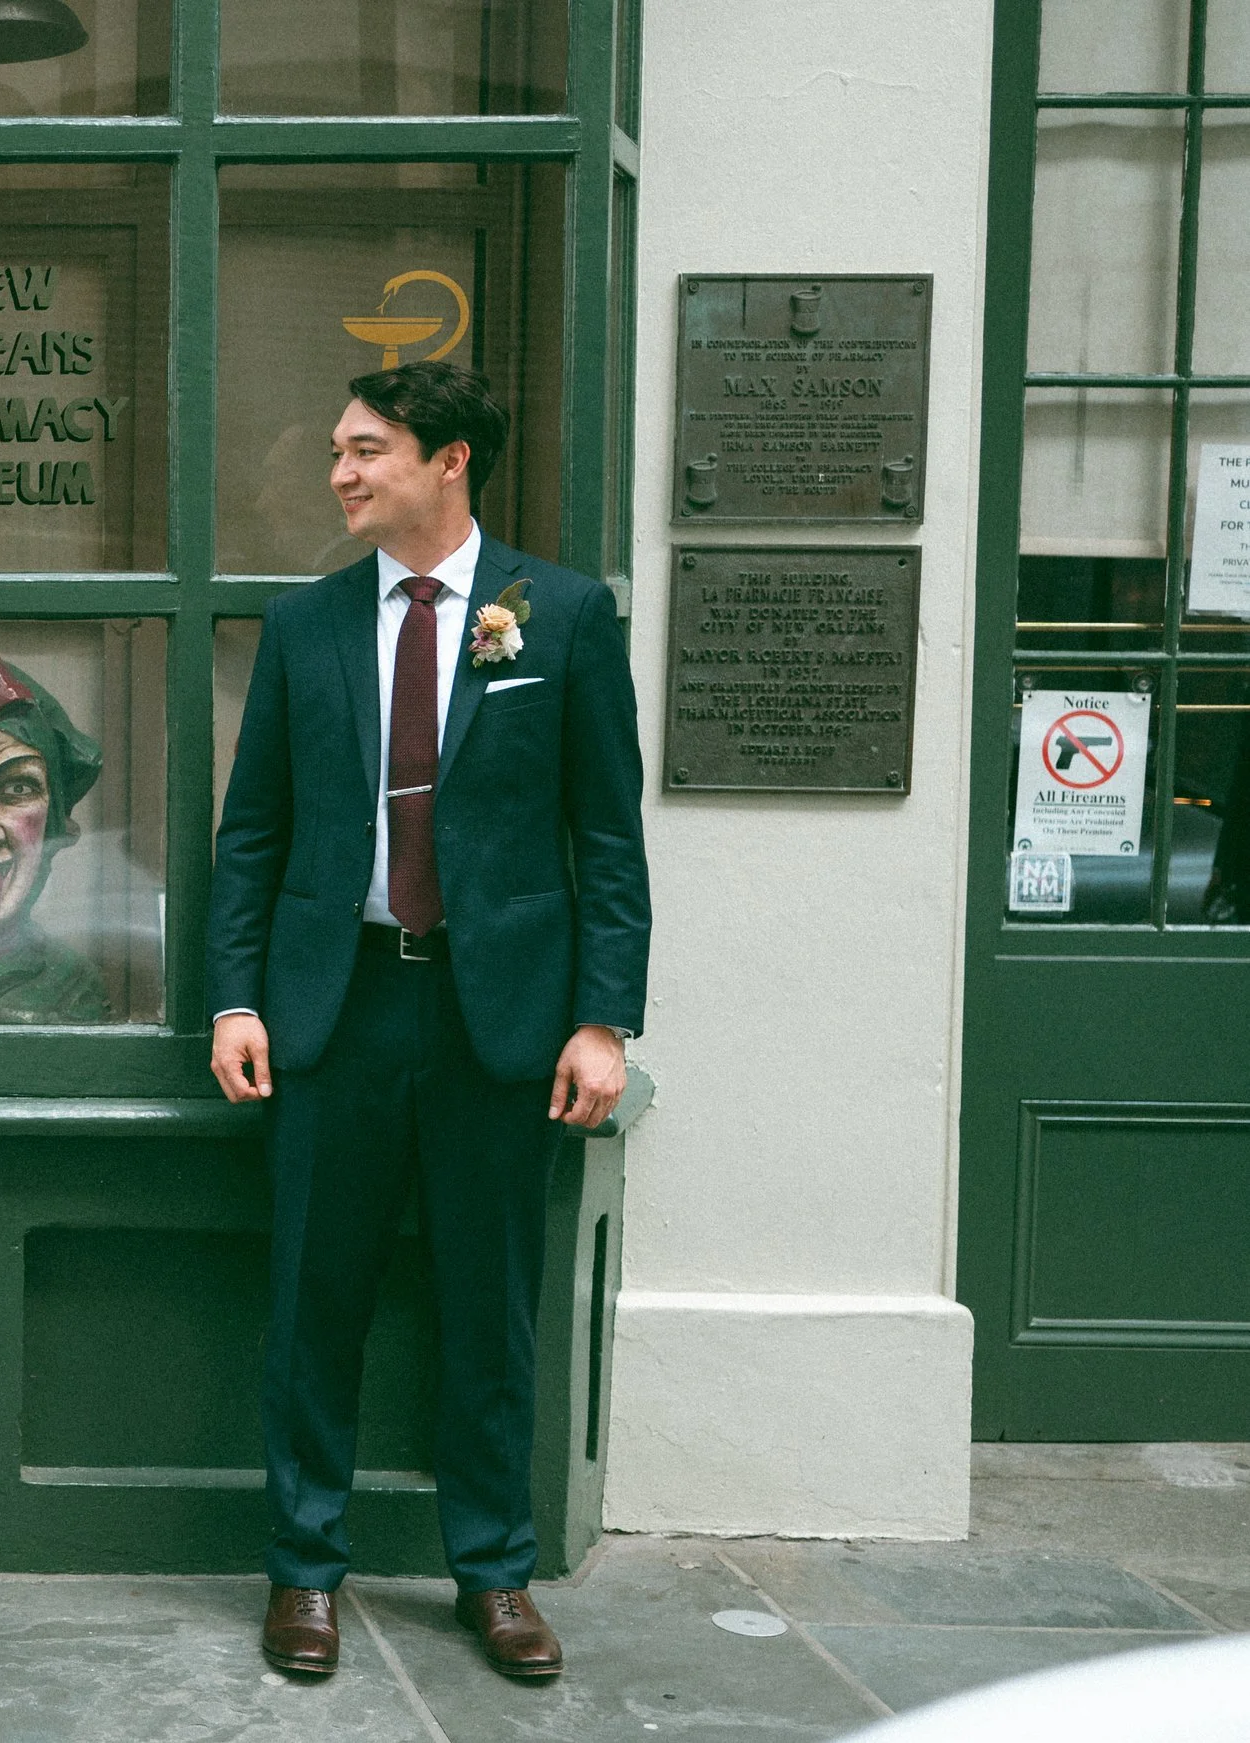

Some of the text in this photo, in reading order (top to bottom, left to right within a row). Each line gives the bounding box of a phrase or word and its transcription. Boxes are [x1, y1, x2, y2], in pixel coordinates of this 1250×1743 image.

[691, 339, 917, 350] IN COMMEMORATION OF THE CONTRIBUTIONS
[724, 352, 887, 362] TO THE SCIENCE OF PHARMACY
[796, 365, 810, 375] BY
[723, 377, 884, 398] MAX SAMSON
[721, 441, 880, 453] IRMA SAMSON BARNETT
[726, 463, 873, 473] THE COLLEGE OF PHARMACY
[1219, 457, 1242, 467] THE
[742, 474, 855, 484] LOYOLA UNIVERSITY
[1220, 521, 1244, 531] FOR
[738, 573, 771, 586] THIS
[702, 588, 719, 604] LA
[725, 588, 802, 604] PHARMACIE
[710, 608, 878, 621] WAS DONATED TO THE
[700, 622, 886, 635] CITY OF NEW ORLEANS
[681, 649, 742, 664] MAYOR
[748, 649, 813, 664] ROBERT
[762, 667, 781, 680] IN
[1064, 696, 1110, 710] Notice
[728, 723, 744, 736] IN
[1034, 791, 1126, 804] All Firearms
[1033, 808, 1126, 817] Including Any Concealed
[1033, 817, 1124, 826] Firearms Are Prohibited
